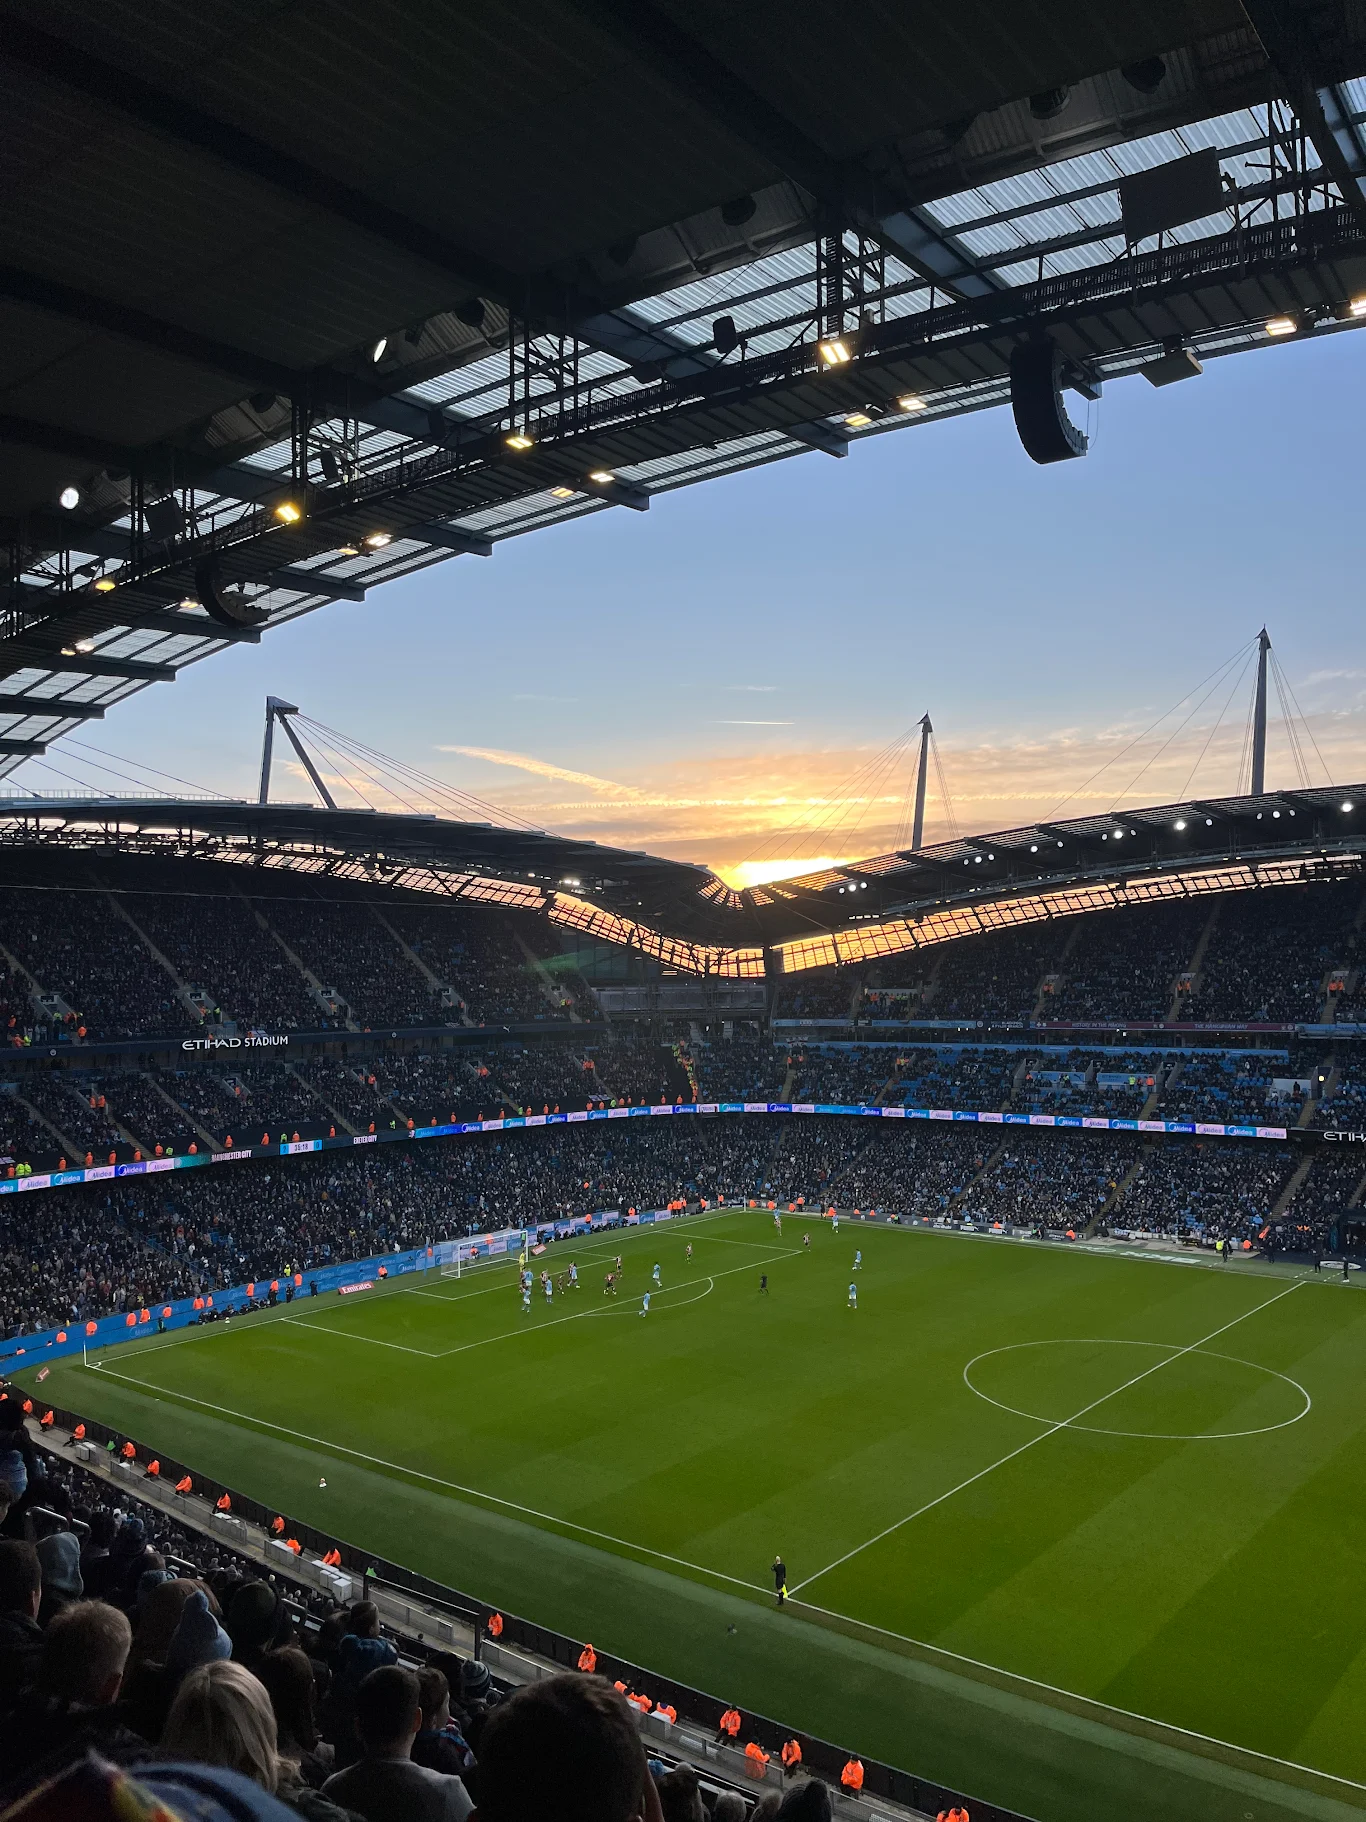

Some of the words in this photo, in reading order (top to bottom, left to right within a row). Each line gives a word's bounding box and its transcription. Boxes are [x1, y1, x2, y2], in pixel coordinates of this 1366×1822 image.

[182, 1038, 241, 1050] ETIHAD
[244, 1035, 288, 1047] STADIUM
[1324, 1132, 1366, 1142] ETIH
[342, 1282, 372, 1294] Emirates
